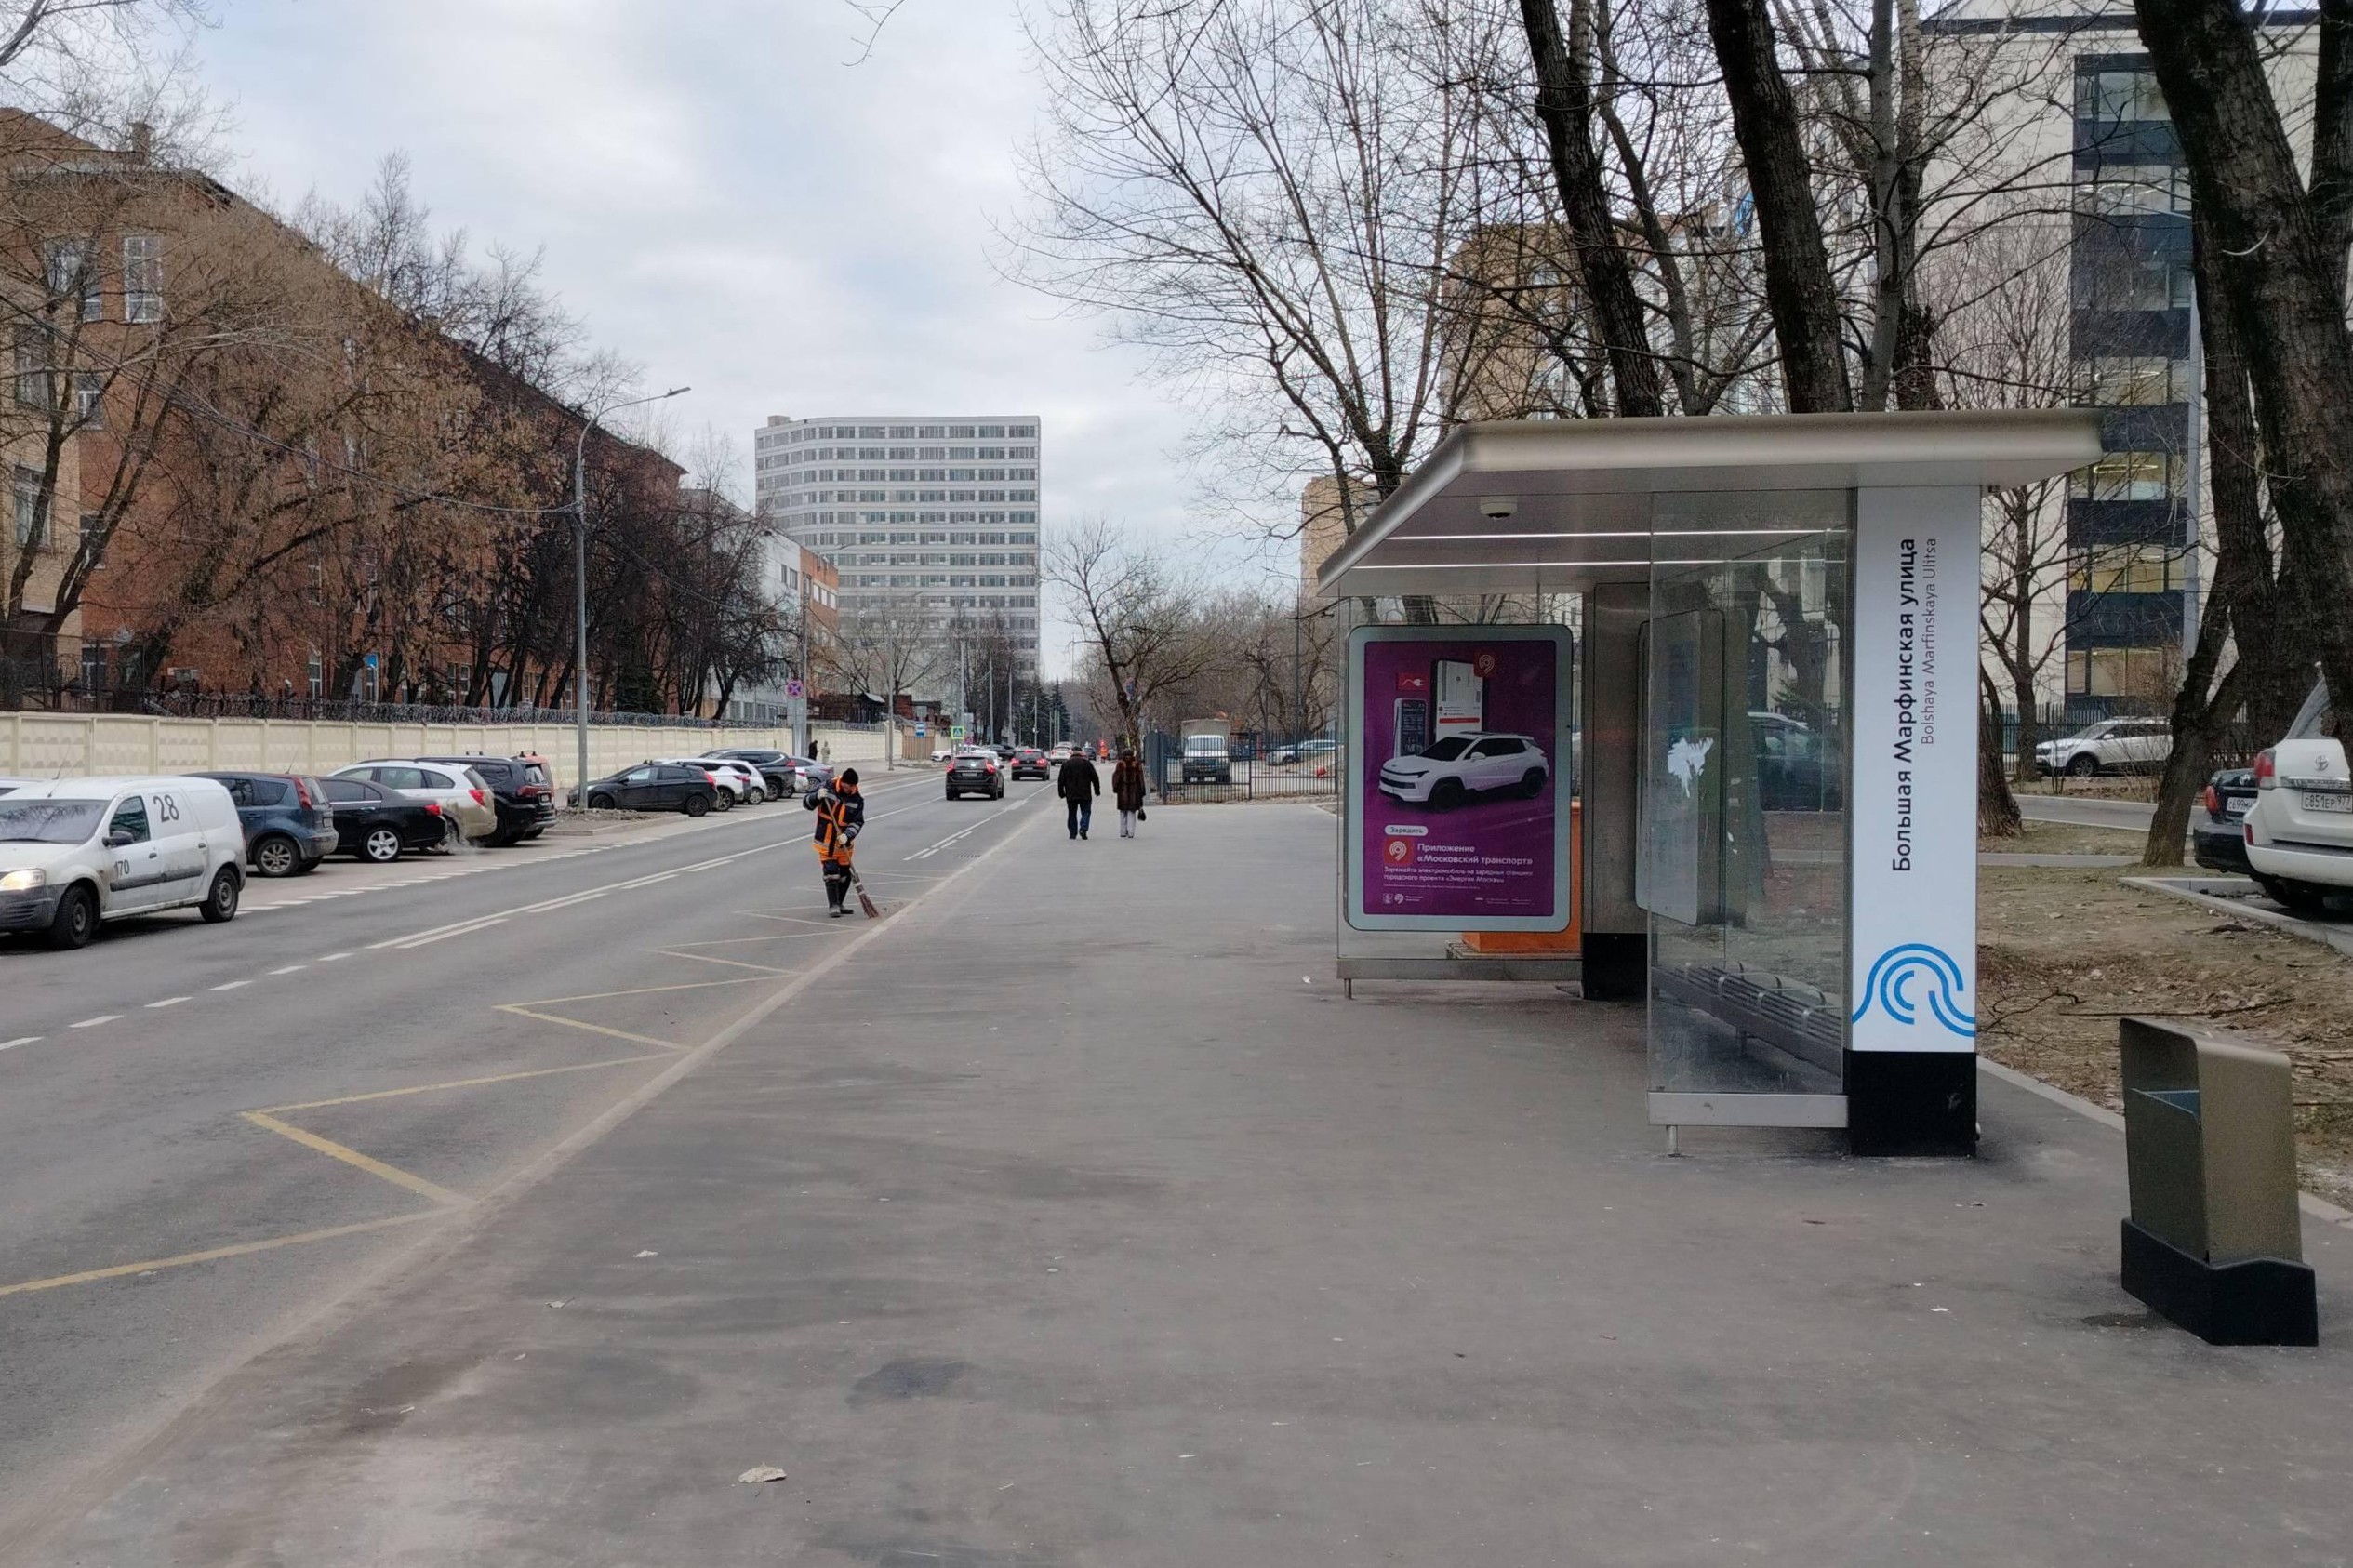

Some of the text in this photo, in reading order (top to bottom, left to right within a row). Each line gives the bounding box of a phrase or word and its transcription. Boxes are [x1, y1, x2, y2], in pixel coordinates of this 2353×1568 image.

[1921, 538, 1938, 745] Bolshaya Marfinskaya Ulitsa
[1892, 538, 1919, 871] Большая Марфинская улица
[153, 794, 179, 823] 28
[1389, 826, 1424, 835] Зарядить
[1417, 843, 1475, 853] Приложение
[113, 859, 130, 876] 170
[1417, 854, 1533, 866] «Московский транспорт»
